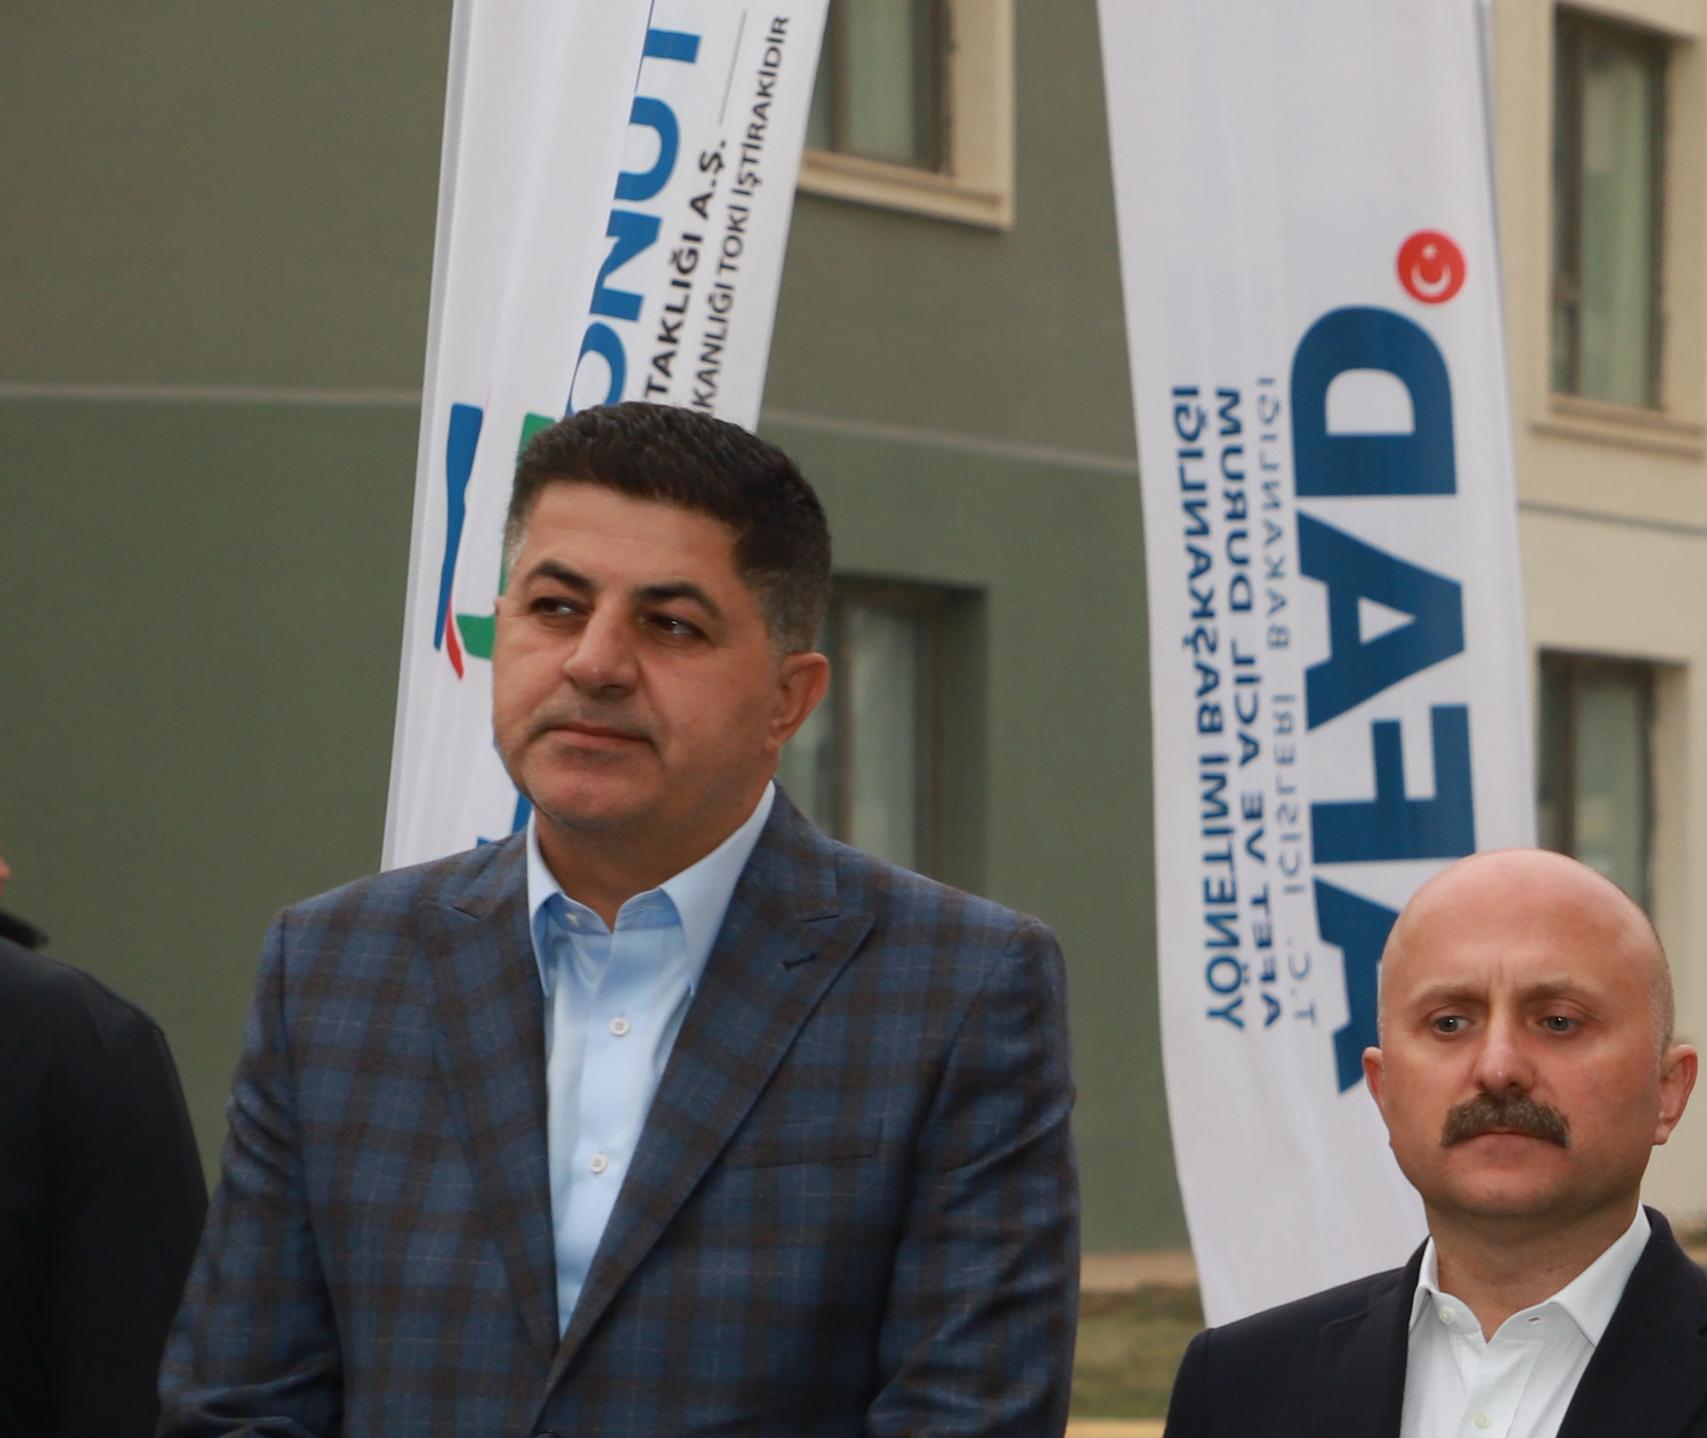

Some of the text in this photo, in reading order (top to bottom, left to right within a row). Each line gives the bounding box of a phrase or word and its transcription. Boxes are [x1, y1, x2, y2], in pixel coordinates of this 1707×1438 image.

[643, 139, 728, 399] TAKLIĞI A.Ş.
[694, 285, 736, 414] KANLIĞI
[734, 15, 790, 198] İŞTİRAKİDİR
